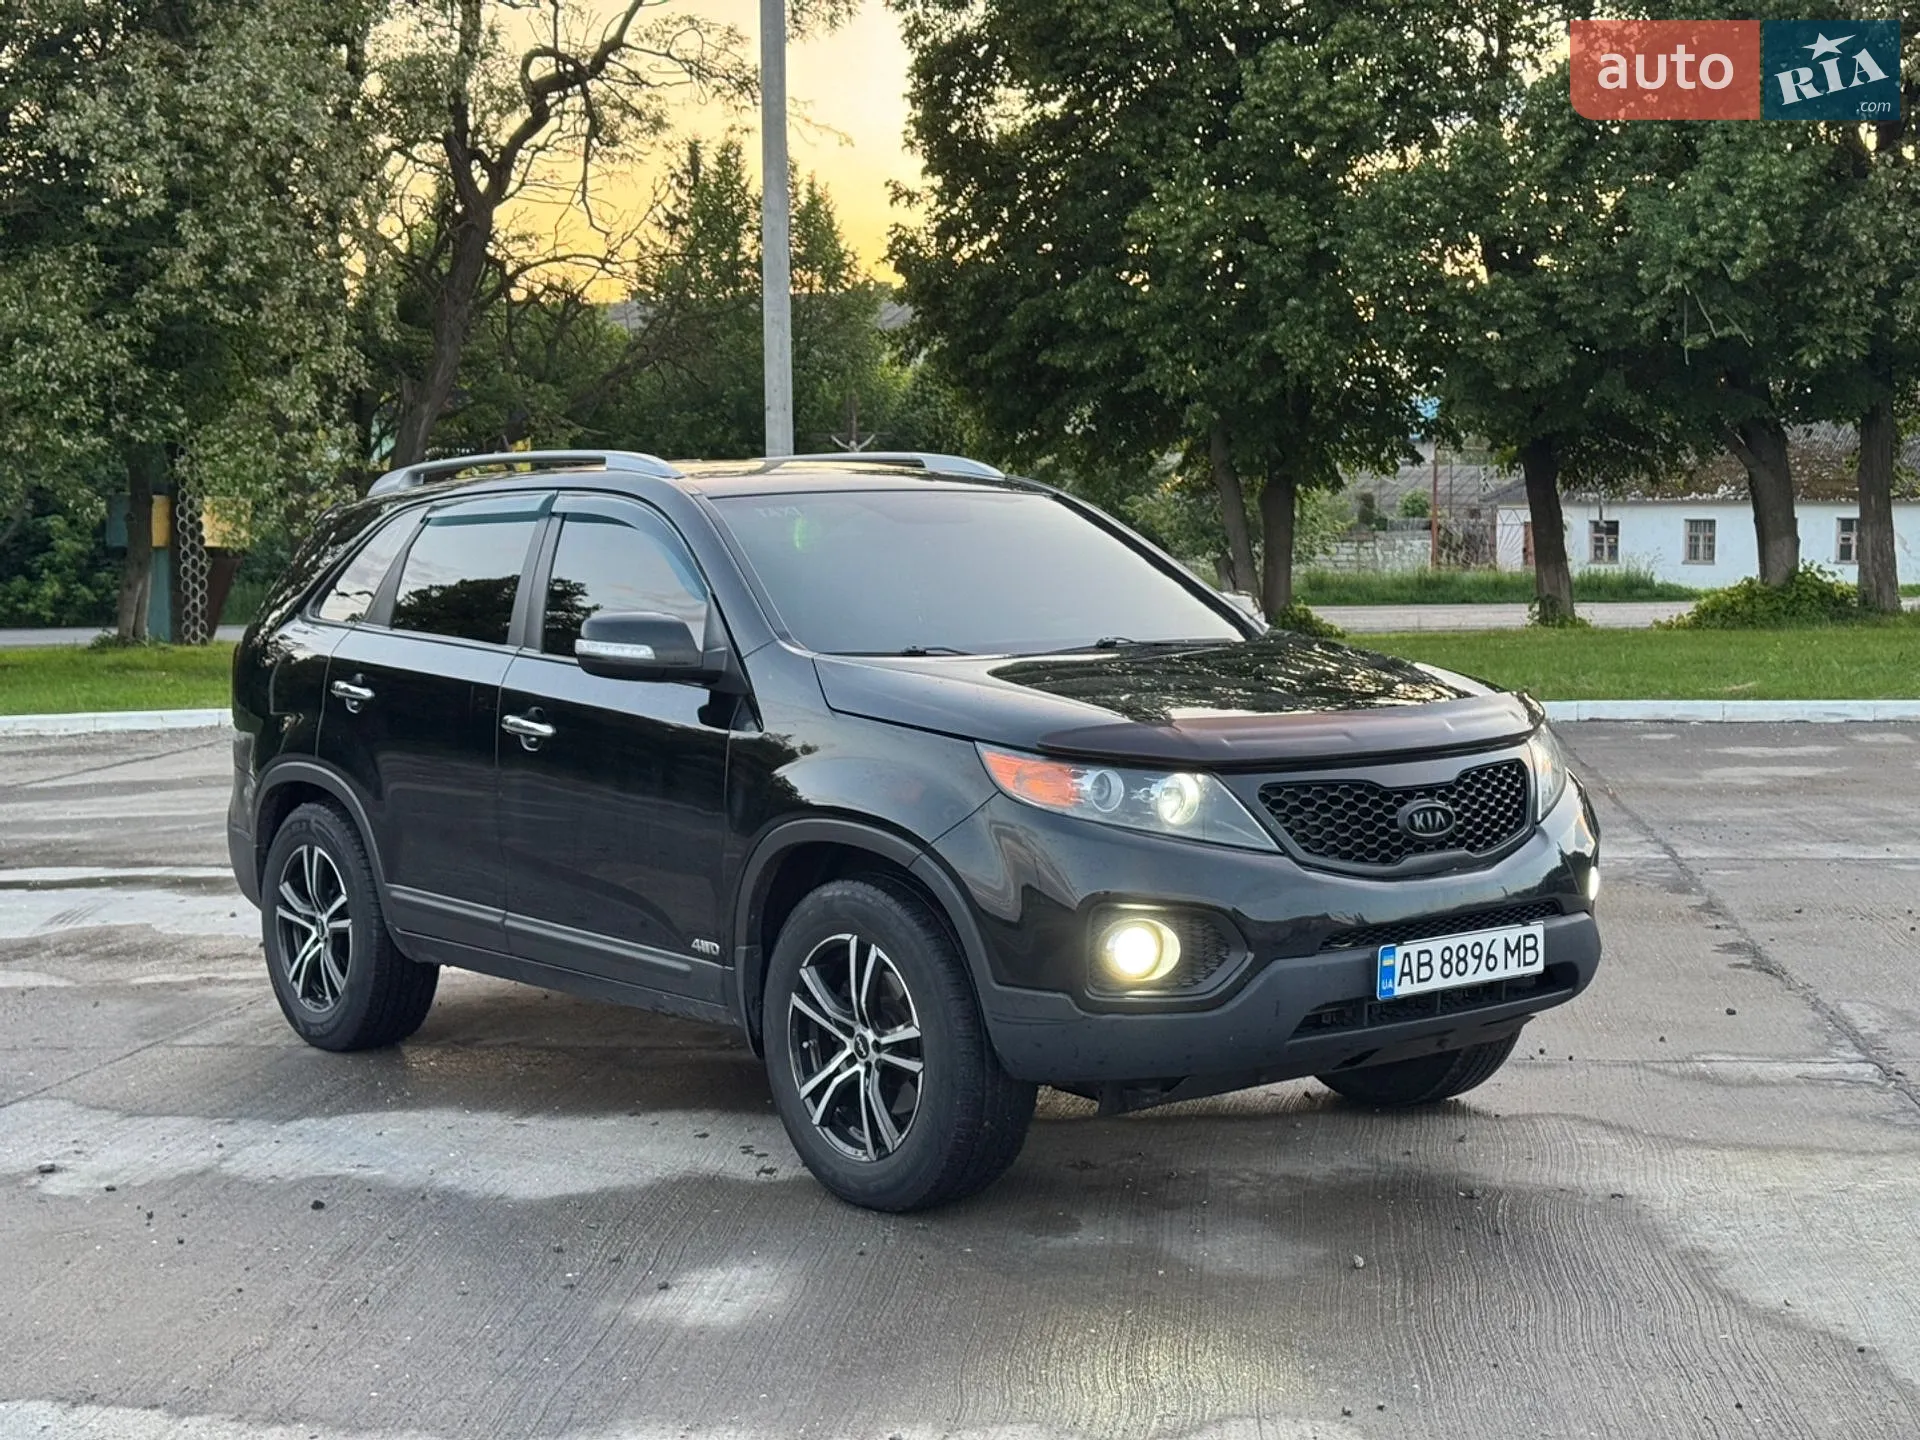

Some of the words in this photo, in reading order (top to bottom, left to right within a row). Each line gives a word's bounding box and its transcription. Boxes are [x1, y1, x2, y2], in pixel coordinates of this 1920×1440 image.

[1413, 811, 1446, 831] KIA
[1397, 949, 1434, 987] AB
[1439, 939, 1498, 980] 8896
[1504, 933, 1539, 970] MB
[1382, 979, 1393, 990] UA
